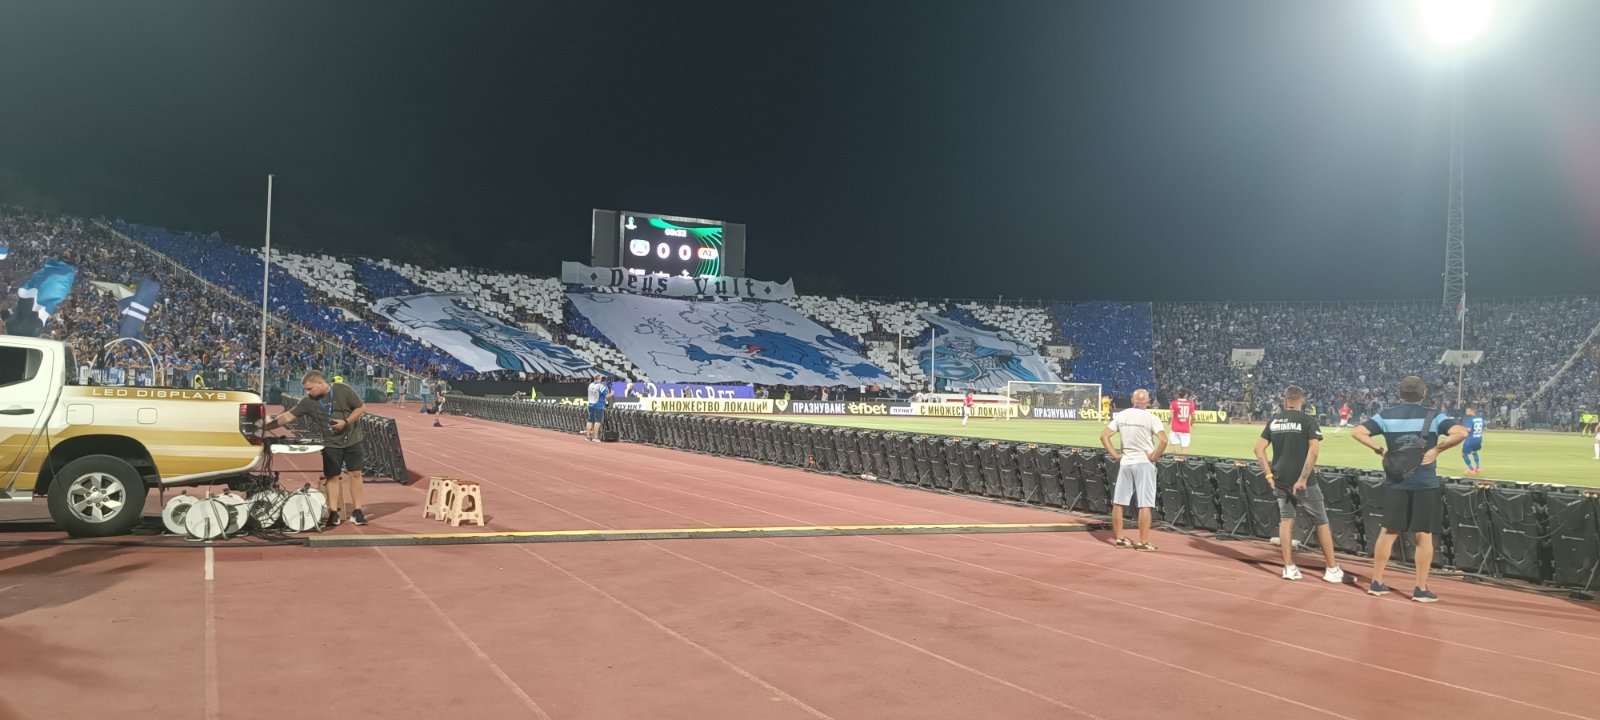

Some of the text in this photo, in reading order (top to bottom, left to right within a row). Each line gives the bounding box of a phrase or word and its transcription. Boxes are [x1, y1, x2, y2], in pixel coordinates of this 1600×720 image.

[657, 242, 691, 261] 0 0
[609, 268, 755, 297] Deus Vult
[92, 388, 227, 400] LED DISPLAYS
[661, 400, 720, 412] МНОЖЕСТВО
[792, 402, 846, 414] ПРАЗНУВАМЕ
[848, 401, 887, 415] efbet
[928, 405, 975, 416] МНОЖЕСО
[1177, 405, 1190, 418] 30
[1473, 421, 1483, 434] 99
